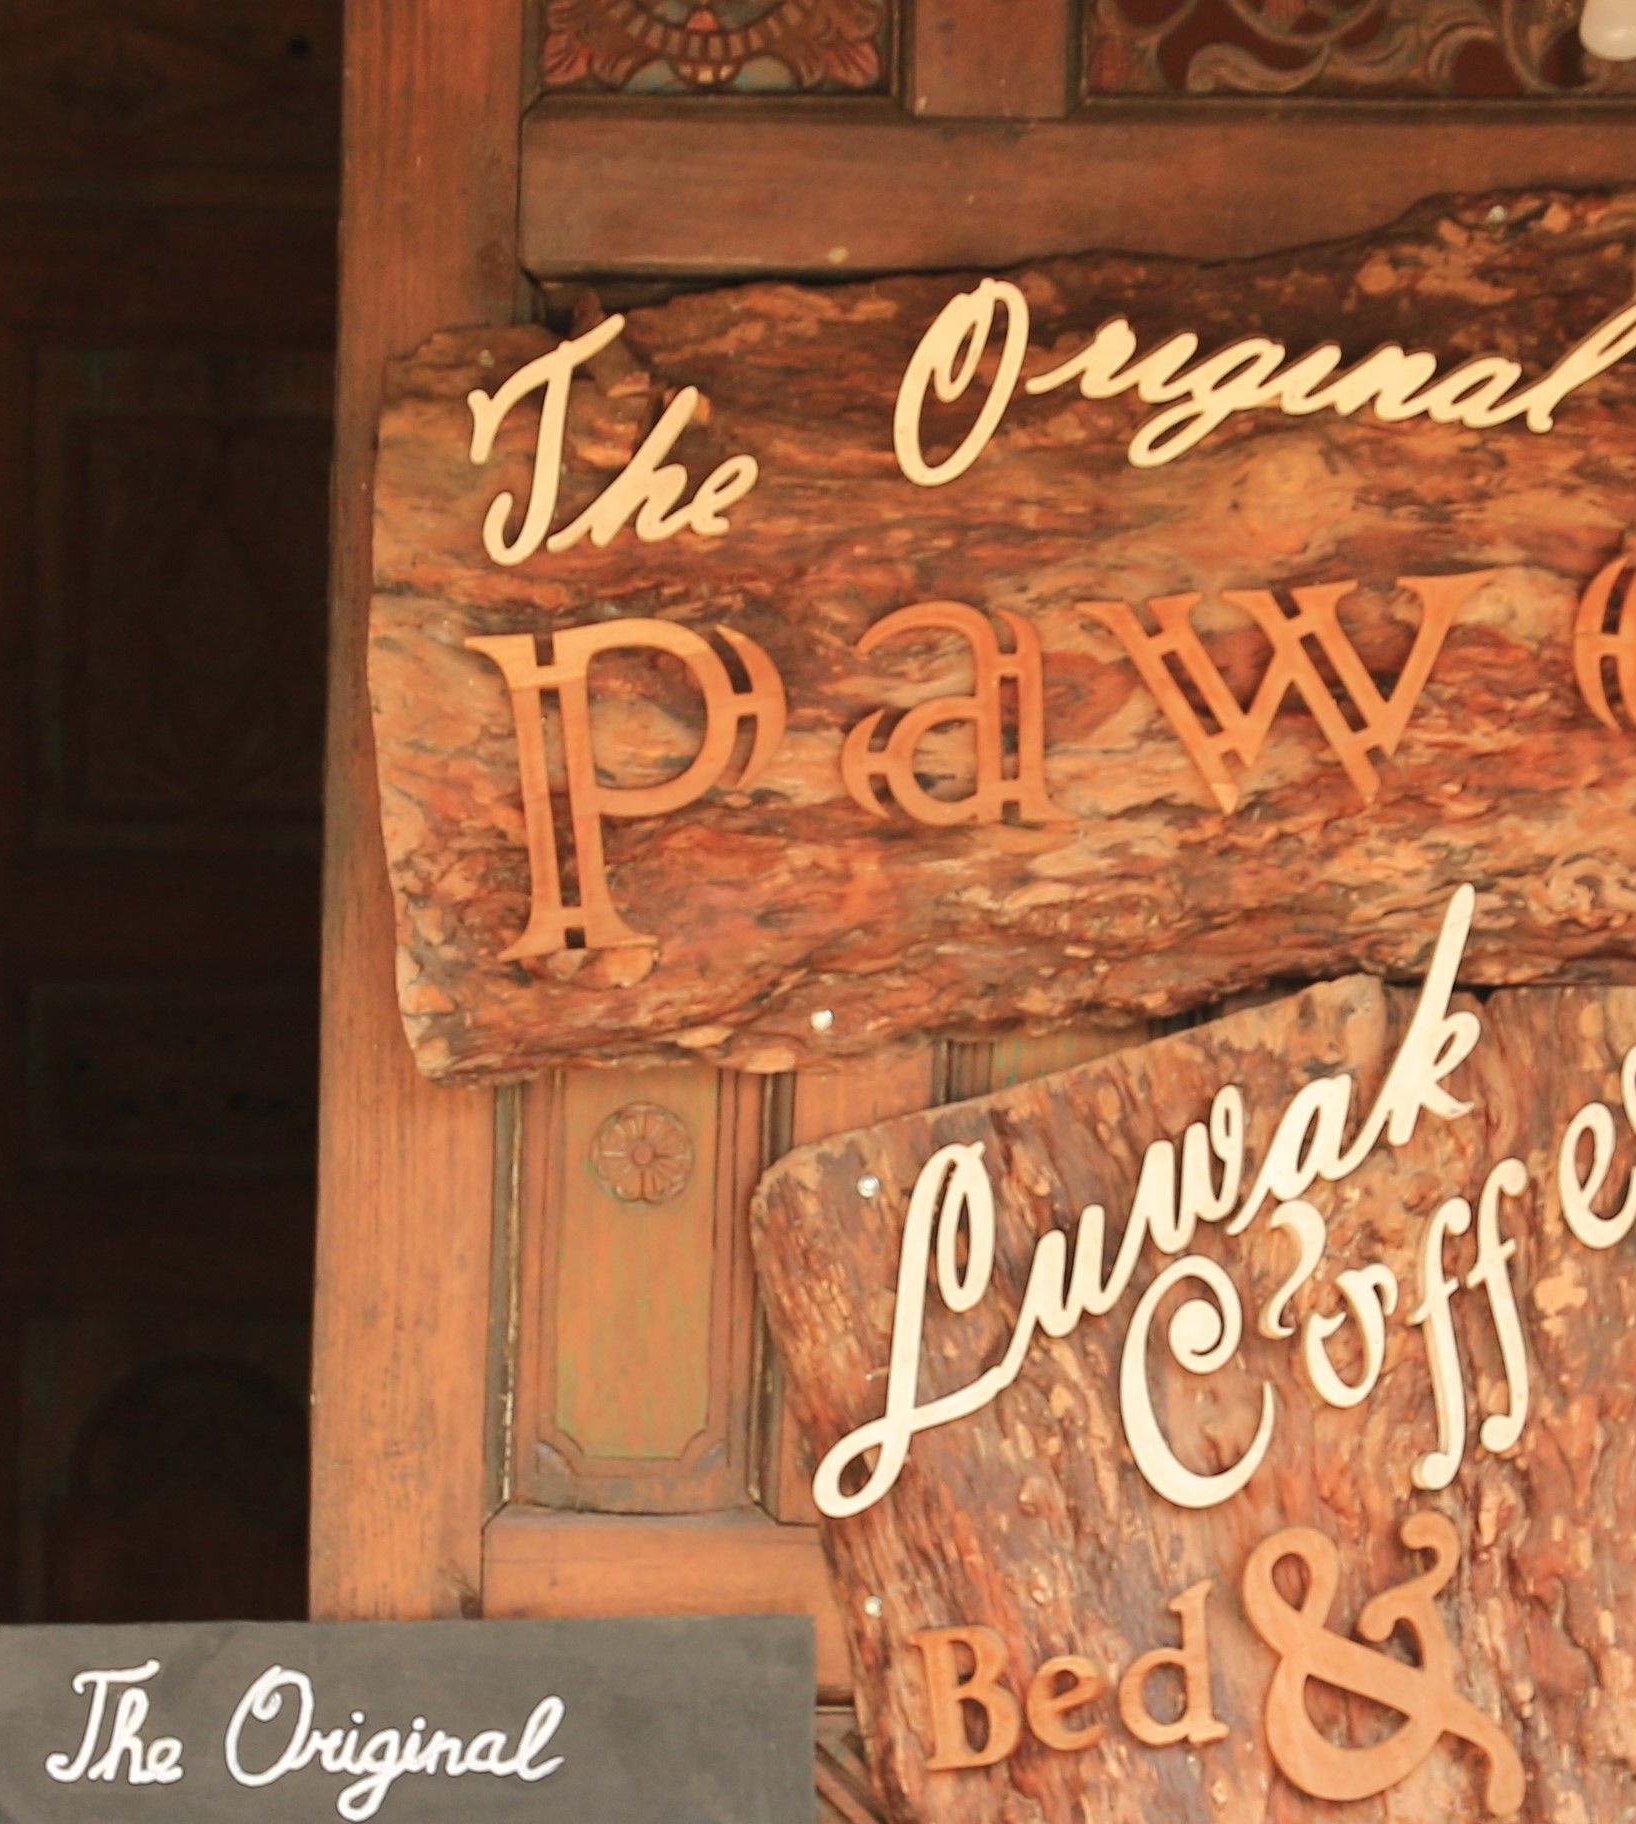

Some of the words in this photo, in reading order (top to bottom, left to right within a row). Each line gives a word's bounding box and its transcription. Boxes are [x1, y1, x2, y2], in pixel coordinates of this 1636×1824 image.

[467, 313, 760, 567] The
[811, 882, 1481, 1518] Luwak
[45, 1659, 186, 1785] The
[223, 1664, 566, 1824] Original
[908, 1578, 1230, 1771] Bed
[1242, 1510, 1526, 1816] &
